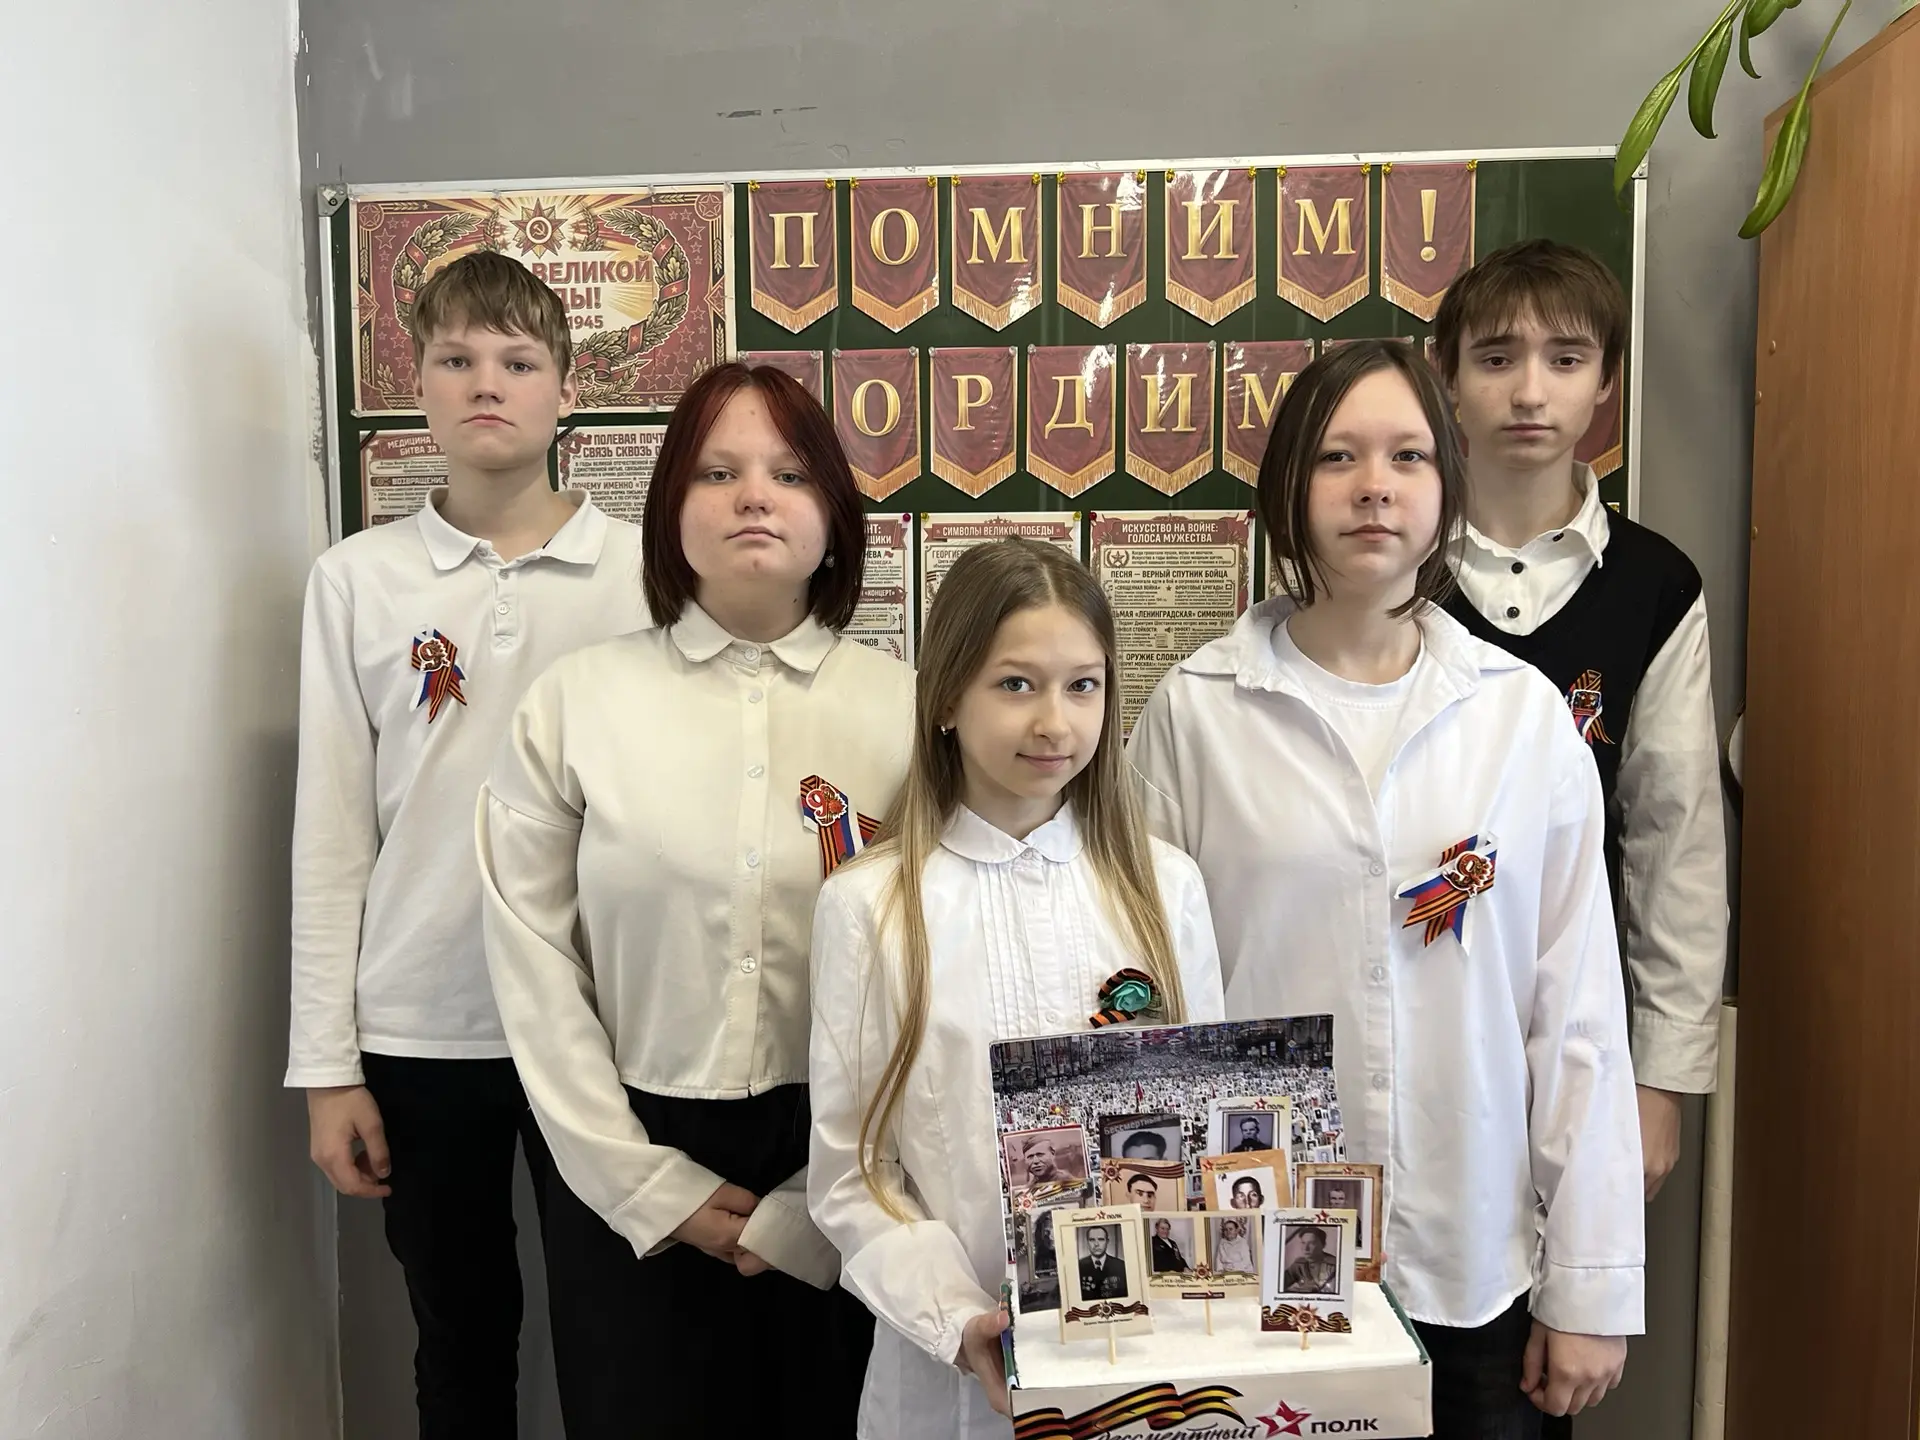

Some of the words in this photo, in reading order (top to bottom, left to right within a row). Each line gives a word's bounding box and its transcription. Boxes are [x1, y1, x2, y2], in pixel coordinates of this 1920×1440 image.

[532, 254, 651, 284] ВЕЛИКОЙ
[795, 371, 1298, 440] ОРДИМ
[387, 436, 431, 449] МЕДИЦИНА
[594, 434, 637, 445] ПОЛЕВАЯ
[400, 446, 425, 456] БИТВА
[426, 445, 437, 454] ЗА
[583, 447, 613, 458] СВЯЗЬ
[616, 446, 652, 457] СКВОЗЬ
[392, 477, 446, 485] ВОЗВРАЩЕНИЕ
[572, 482, 601, 490] ПОЧЕМУ
[603, 481, 633, 489] ИМЕННО
[942, 526, 982, 536] СИМВОЛЫ
[983, 523, 1020, 536] ВЕЛИКОЙ
[1021, 525, 1054, 537] ПОБЕДЫ
[1121, 523, 1171, 533] ИСКУССТВО
[1173, 523, 1187, 532] НА
[1188, 521, 1218, 533] ВОЙНЕ:
[1127, 533, 1161, 543] ГОЛОСА
[1163, 533, 1212, 543] МУЖЕСТВА
[1110, 570, 1132, 578] ПЕСНЯ
[1142, 568, 1171, 578] ВЕРНЫЙ
[1172, 569, 1203, 577] СПУТНИК
[1204, 568, 1228, 579] БОЙЦА
[864, 589, 896, 597] «КОНЦЕРТ»
[1135, 610, 1196, 619] «ЛЕНИНГРАДСКАЯ»
[1197, 610, 1235, 618] СИМФОНИЯ
[1126, 653, 1155, 661] ОРУЖИЕ
[1156, 653, 1179, 661] СЛОВА
[1311, 1417, 1379, 1434] ПОЛК
